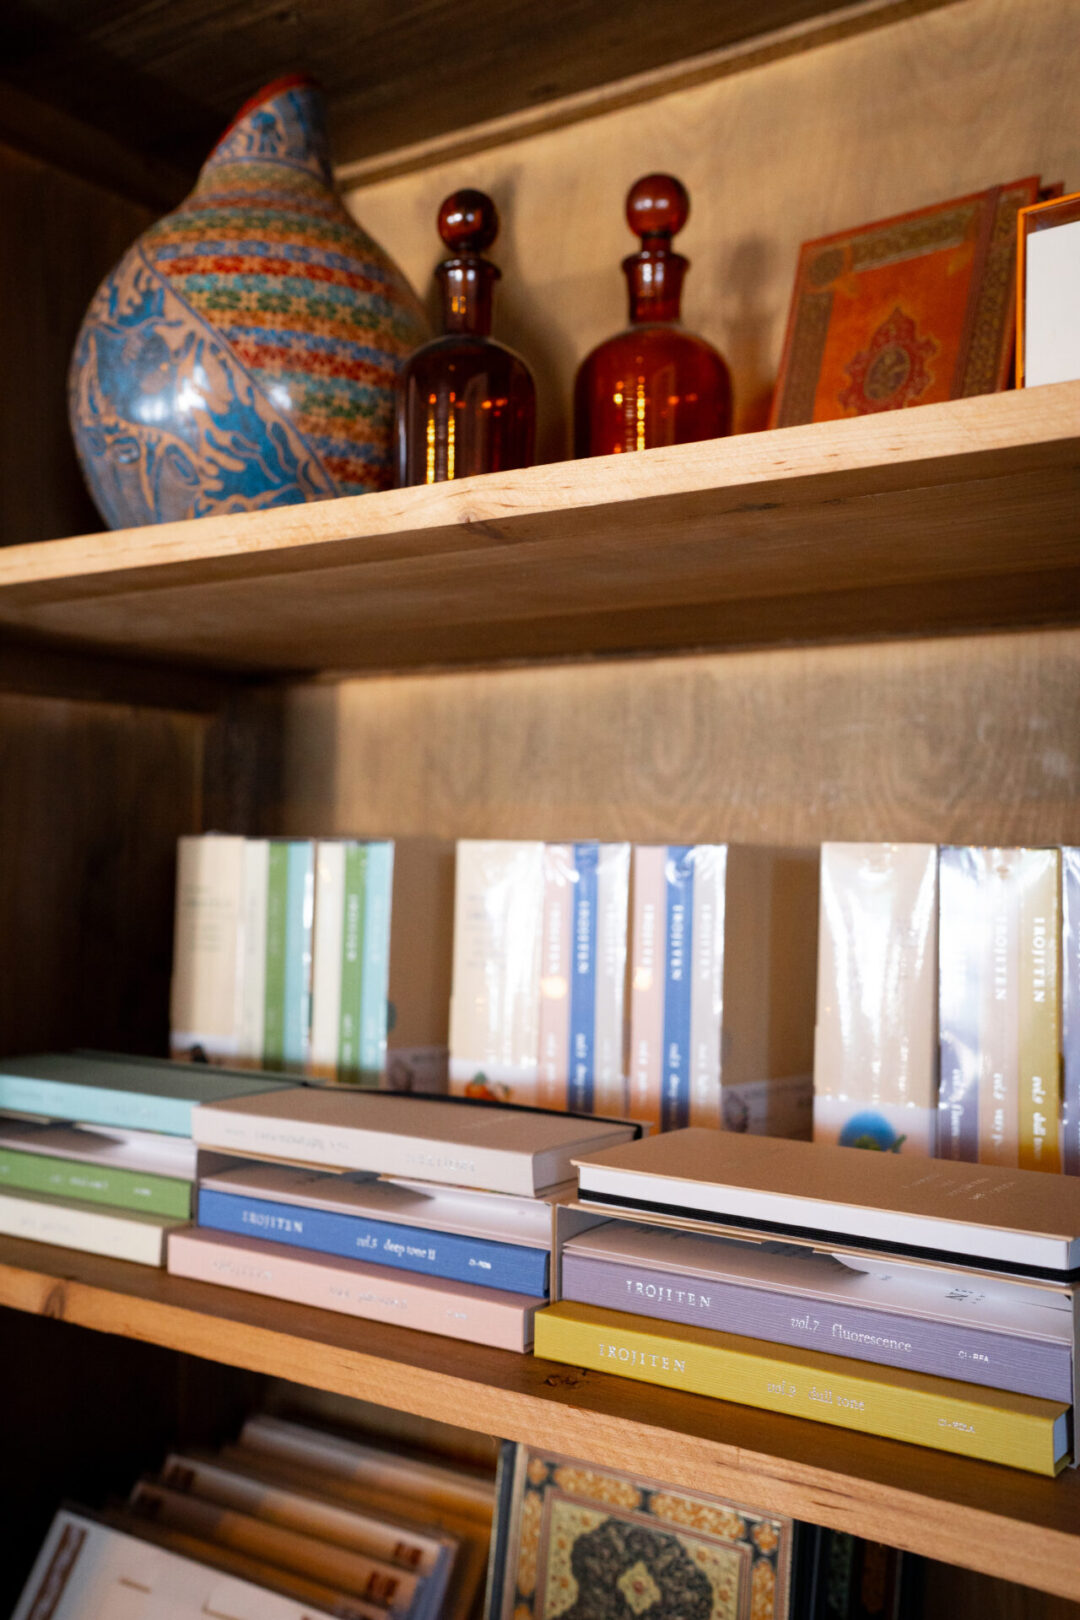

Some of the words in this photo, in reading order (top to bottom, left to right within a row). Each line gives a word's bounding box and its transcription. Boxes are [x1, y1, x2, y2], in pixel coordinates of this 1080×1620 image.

[1032, 917, 1046, 1002] IROJITEN
[242, 1211, 303, 1233] IROJITEN
[626, 1280, 711, 1308] IROJITEN
[791, 1315, 820, 1333] vol.7
[831, 1323, 913, 1353] fluorescence
[599, 1343, 687, 1373] IROJITEN
[808, 1386, 833, 1404] dull
[836, 1394, 865, 1411] tone
